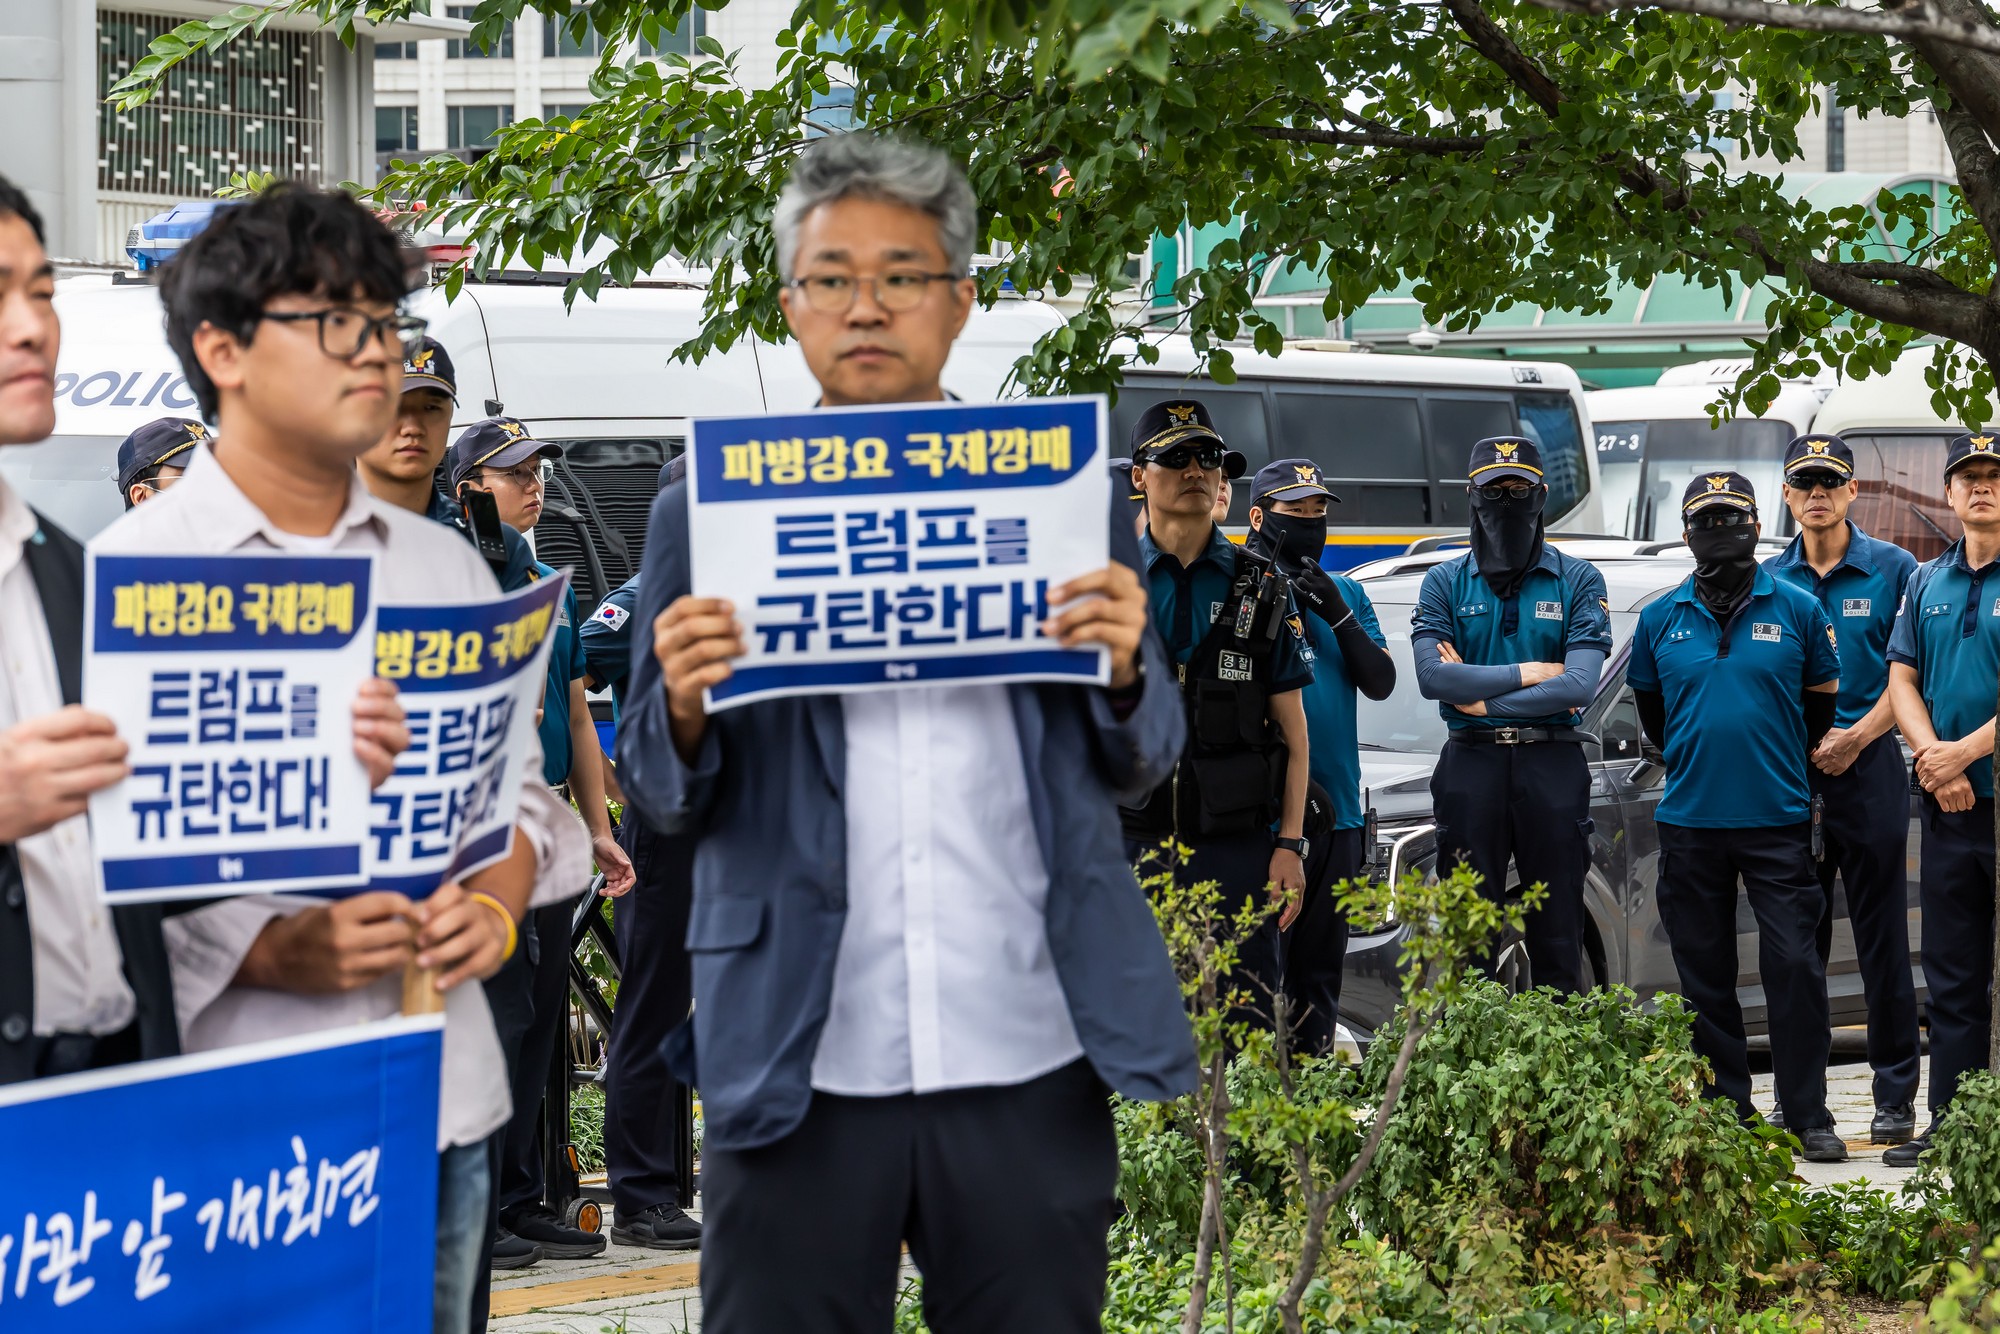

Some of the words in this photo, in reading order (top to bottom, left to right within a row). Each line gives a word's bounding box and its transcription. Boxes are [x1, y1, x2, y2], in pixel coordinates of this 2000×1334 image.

[53, 371, 200, 410] POLIC
[721, 434, 894, 486] 파병강요
[902, 424, 1072, 478] 국제깡패
[775, 505, 1029, 579] 트럼프를
[112, 581, 236, 637] 파병강요
[240, 581, 355, 636] 국제깡패
[755, 579, 1048, 653] 규탄한다!
[375, 629, 483, 679] 병강요
[1221, 669, 1249, 681] POLICE
[146, 668, 318, 746] 트럼프를
[130, 757, 329, 841] 규탄한다!
[121, 1176, 188, 1302] 앞
[196, 1134, 381, 1254] 기자회견
